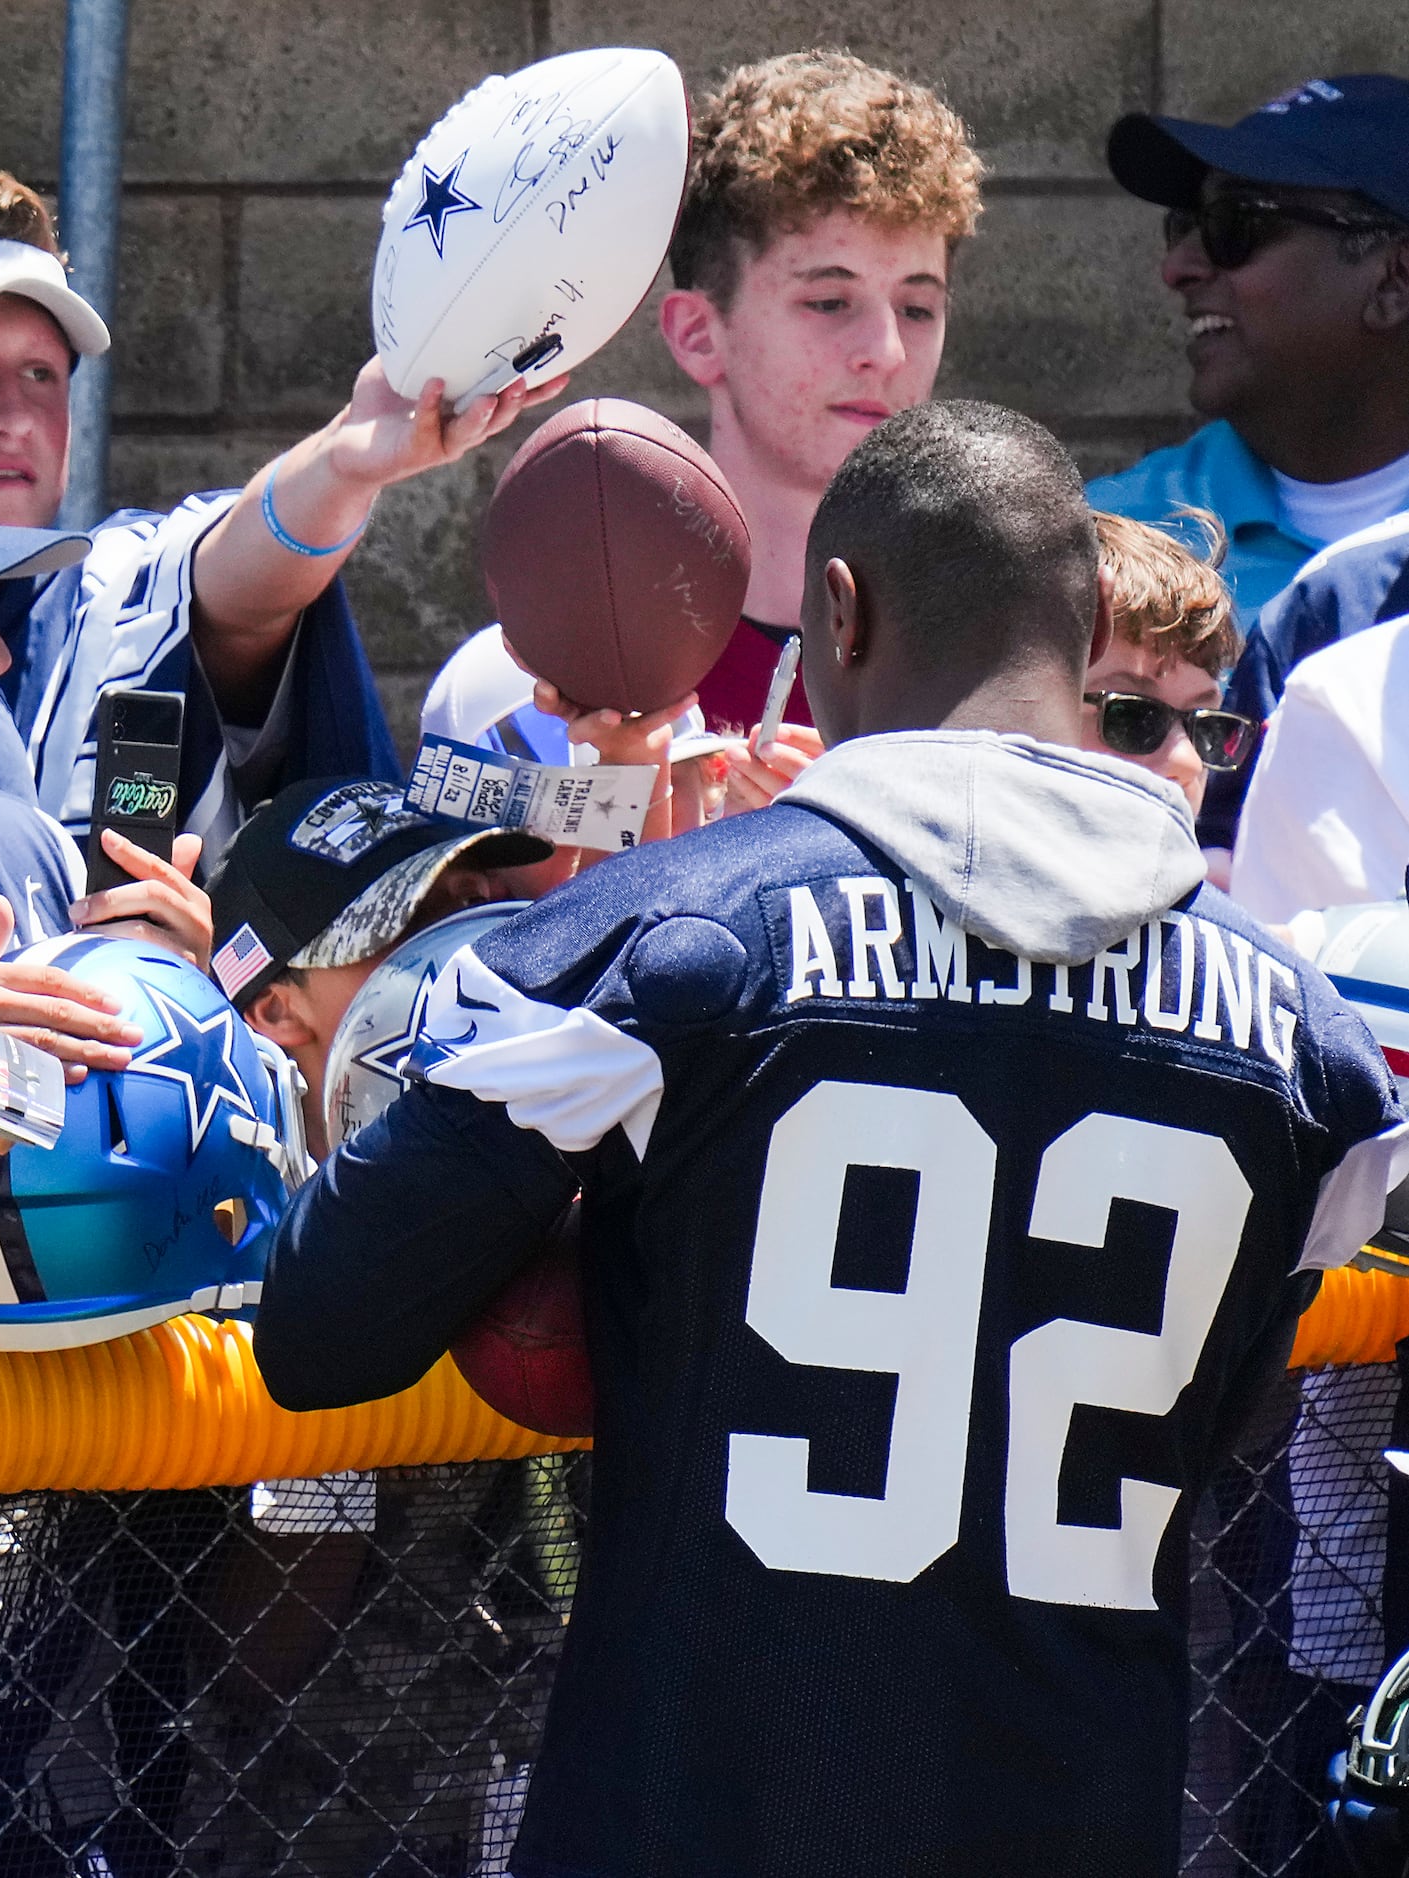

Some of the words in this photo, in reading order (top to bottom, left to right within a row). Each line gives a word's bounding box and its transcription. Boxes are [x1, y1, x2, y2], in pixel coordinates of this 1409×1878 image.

[557, 778, 576, 809] CAMP
[563, 777, 593, 834] TRAINING
[725, 1079, 1254, 1611] 92
